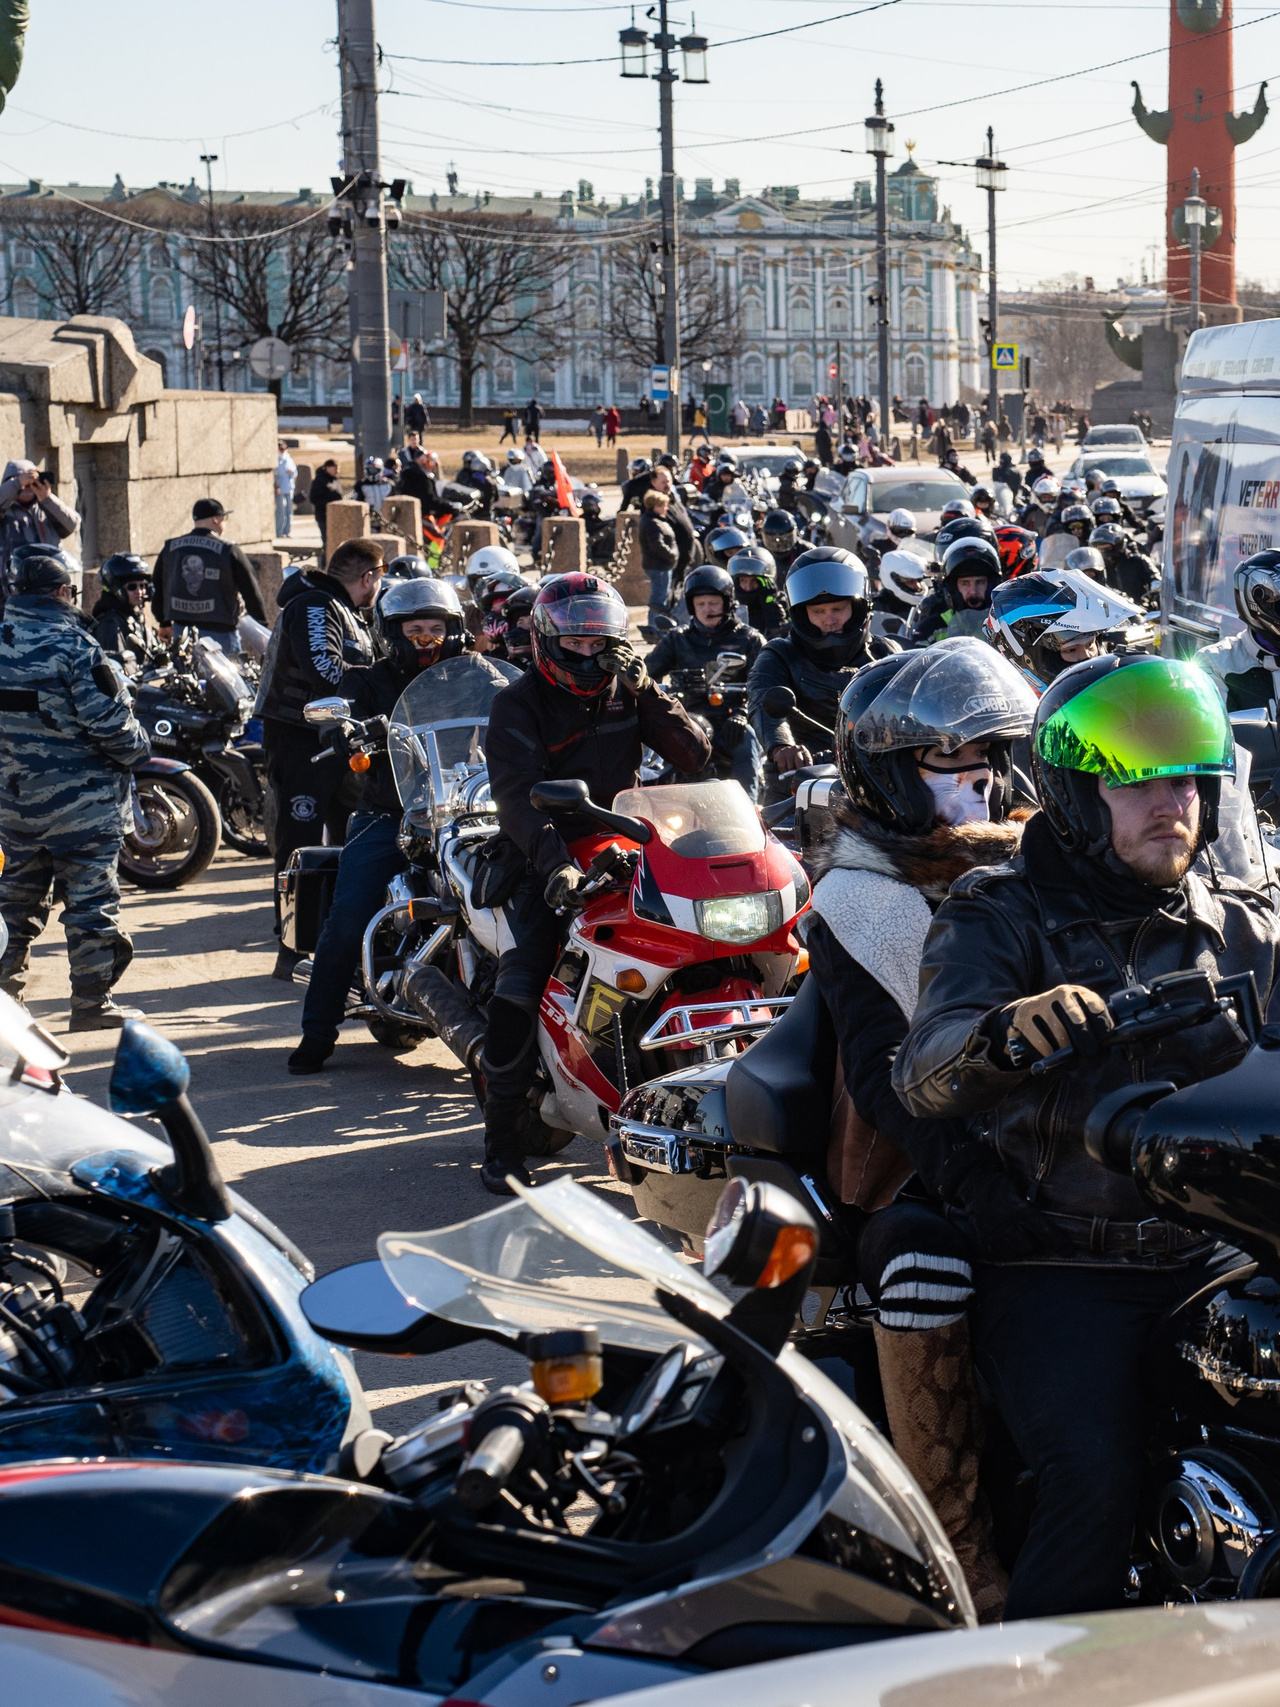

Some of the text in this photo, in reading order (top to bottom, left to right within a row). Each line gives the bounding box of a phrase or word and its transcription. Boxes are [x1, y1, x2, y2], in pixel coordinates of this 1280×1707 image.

[1239, 480, 1280, 509] VETERR
[174, 601, 212, 611] RUSSIA
[306, 606, 328, 652] NORMANS
[1054, 621, 1080, 630] Mxsport
[969, 696, 1009, 713] SHOEI
